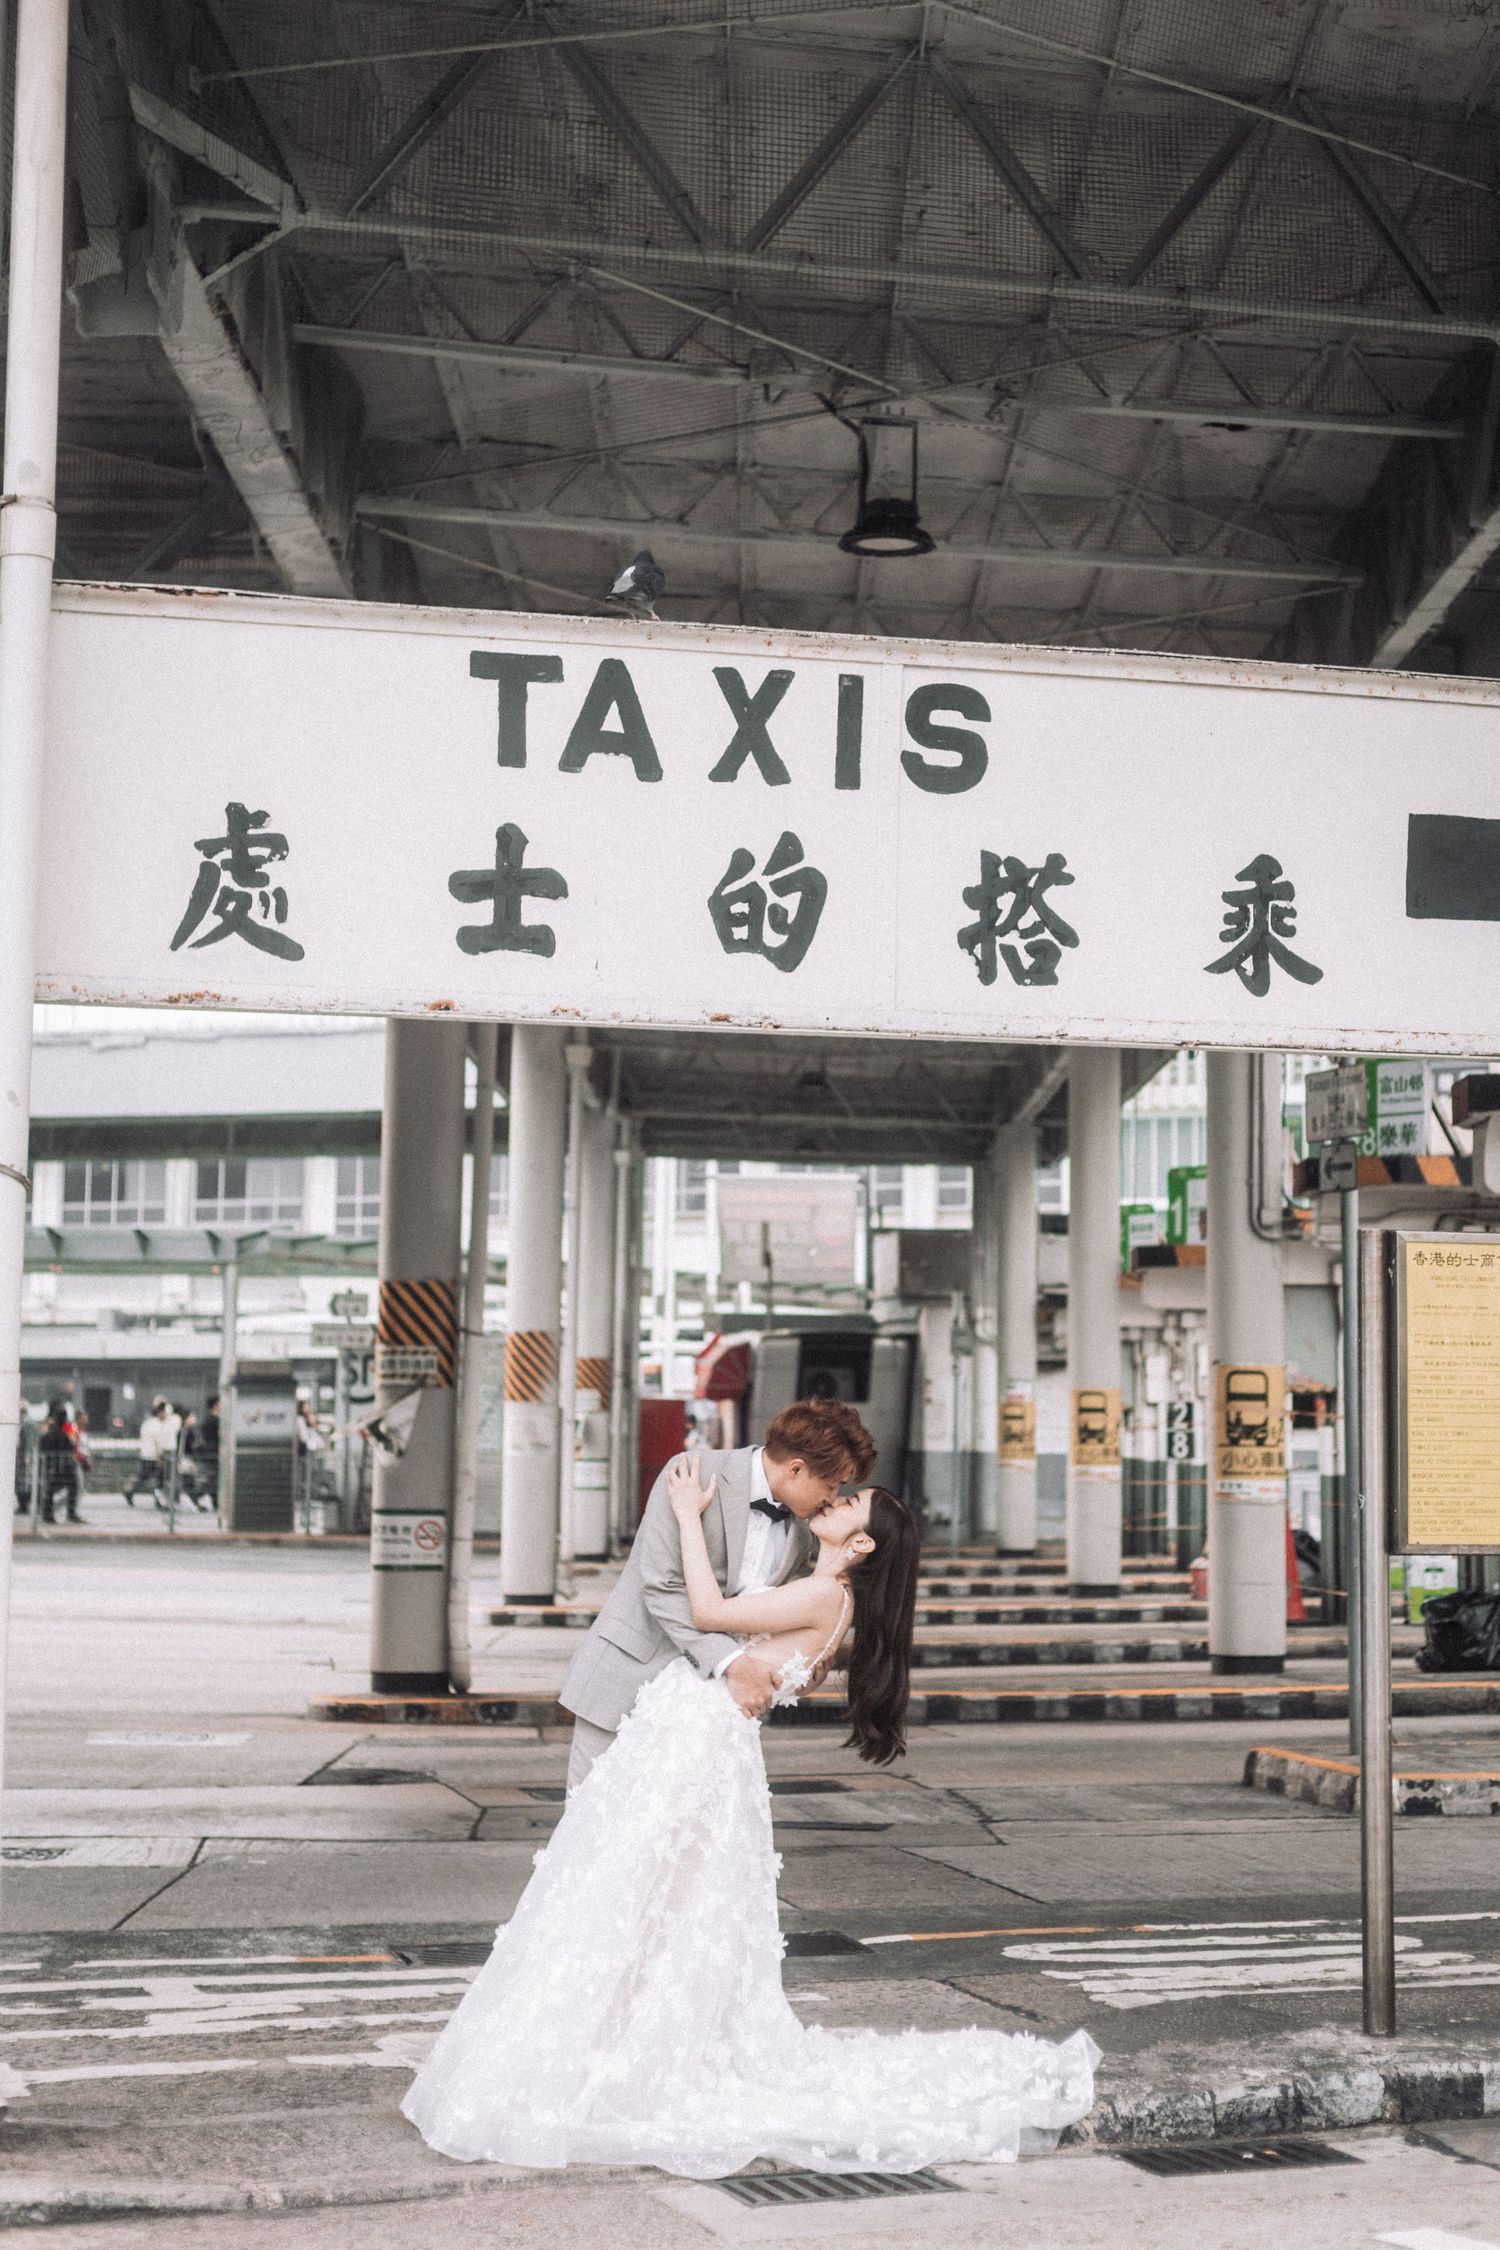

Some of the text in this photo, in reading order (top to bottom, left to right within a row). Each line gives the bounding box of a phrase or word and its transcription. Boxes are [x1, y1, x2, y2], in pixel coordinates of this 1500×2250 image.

[470, 650, 991, 795] TAXIS
[1413, 1251, 1500, 1268] 香港的士商
